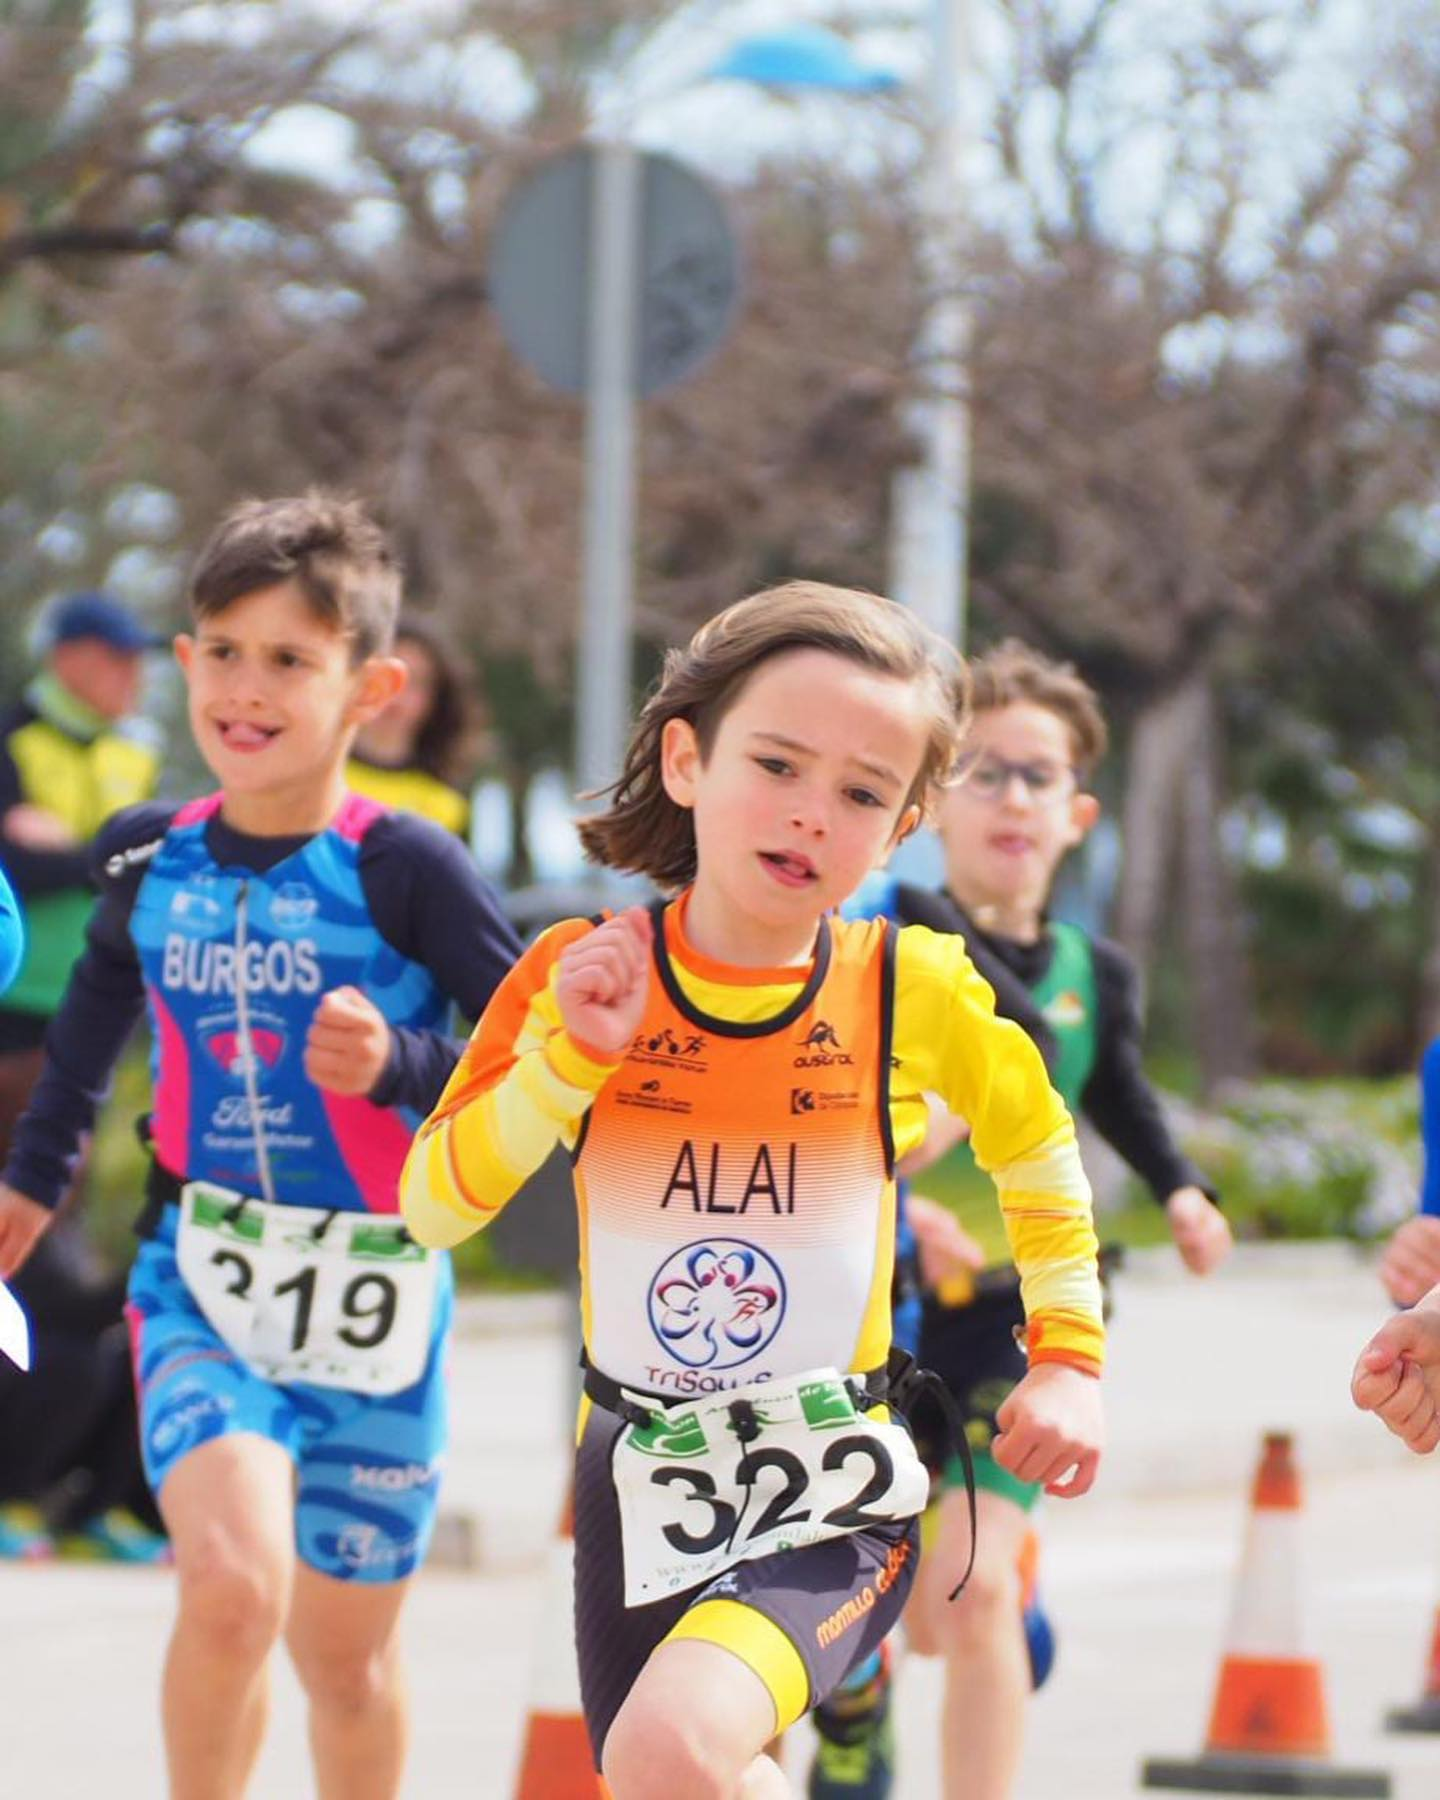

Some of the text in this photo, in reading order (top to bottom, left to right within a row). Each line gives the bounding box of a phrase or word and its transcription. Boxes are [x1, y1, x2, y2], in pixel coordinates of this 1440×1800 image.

[164, 933, 320, 994] BURGOS
[659, 1139, 797, 1215] ALAI
[650, 1435, 894, 1554] 322
